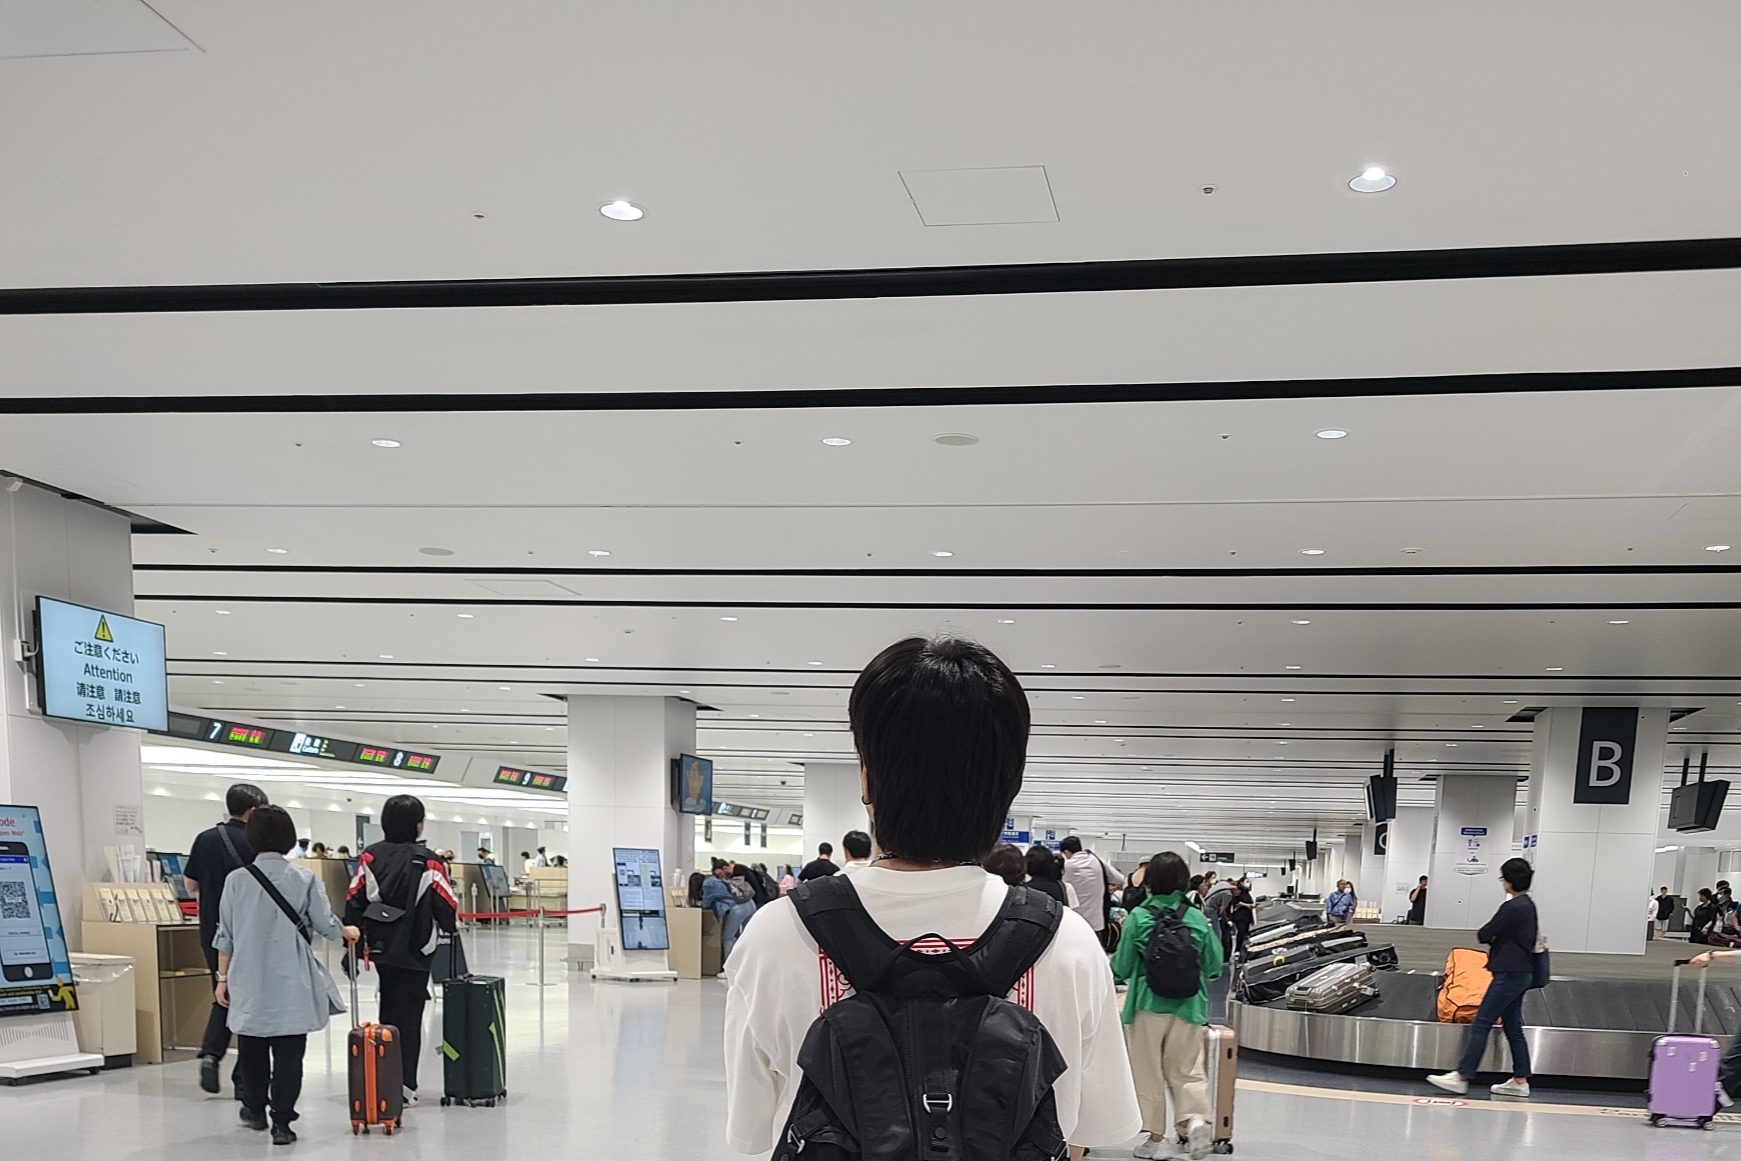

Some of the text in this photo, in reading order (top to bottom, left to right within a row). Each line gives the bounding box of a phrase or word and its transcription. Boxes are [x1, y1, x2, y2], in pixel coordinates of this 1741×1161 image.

[74, 640, 140, 665] ご注意ください
[83, 663, 133, 684] Attention
[76, 681, 142, 705] 请注意 請注意
[85, 703, 135, 723] 조심하세요
[209, 722, 222, 739] 7
[393, 751, 404, 767] 8
[1588, 741, 1623, 787] B
[522, 772, 532, 785] 9
